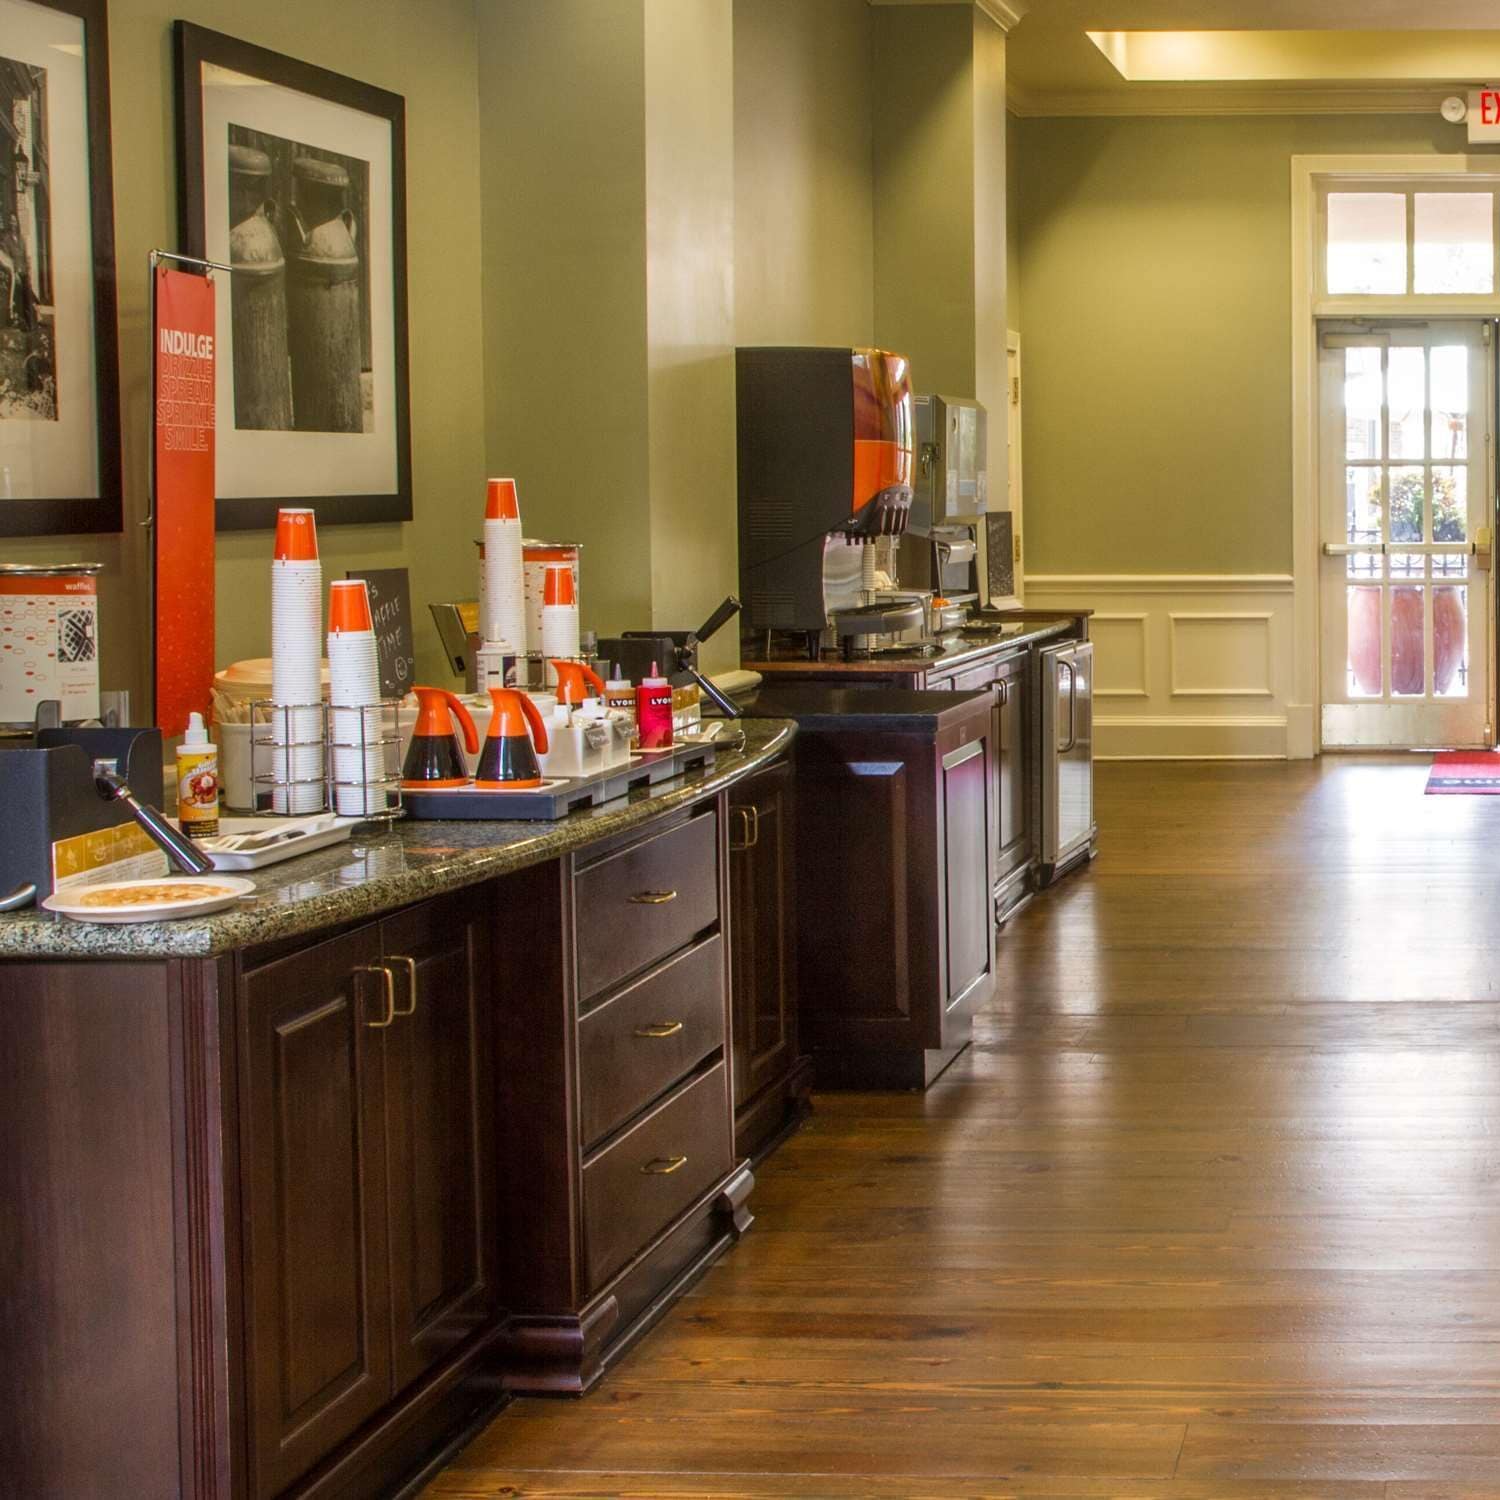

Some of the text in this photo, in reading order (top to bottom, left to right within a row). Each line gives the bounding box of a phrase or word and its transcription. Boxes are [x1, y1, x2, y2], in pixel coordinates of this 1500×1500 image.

[160, 328, 214, 360] INDULGE
[160, 353, 213, 382] DRIZZLE
[160, 376, 213, 405] SPREAD
[156, 399, 216, 430] SPRINKLE
